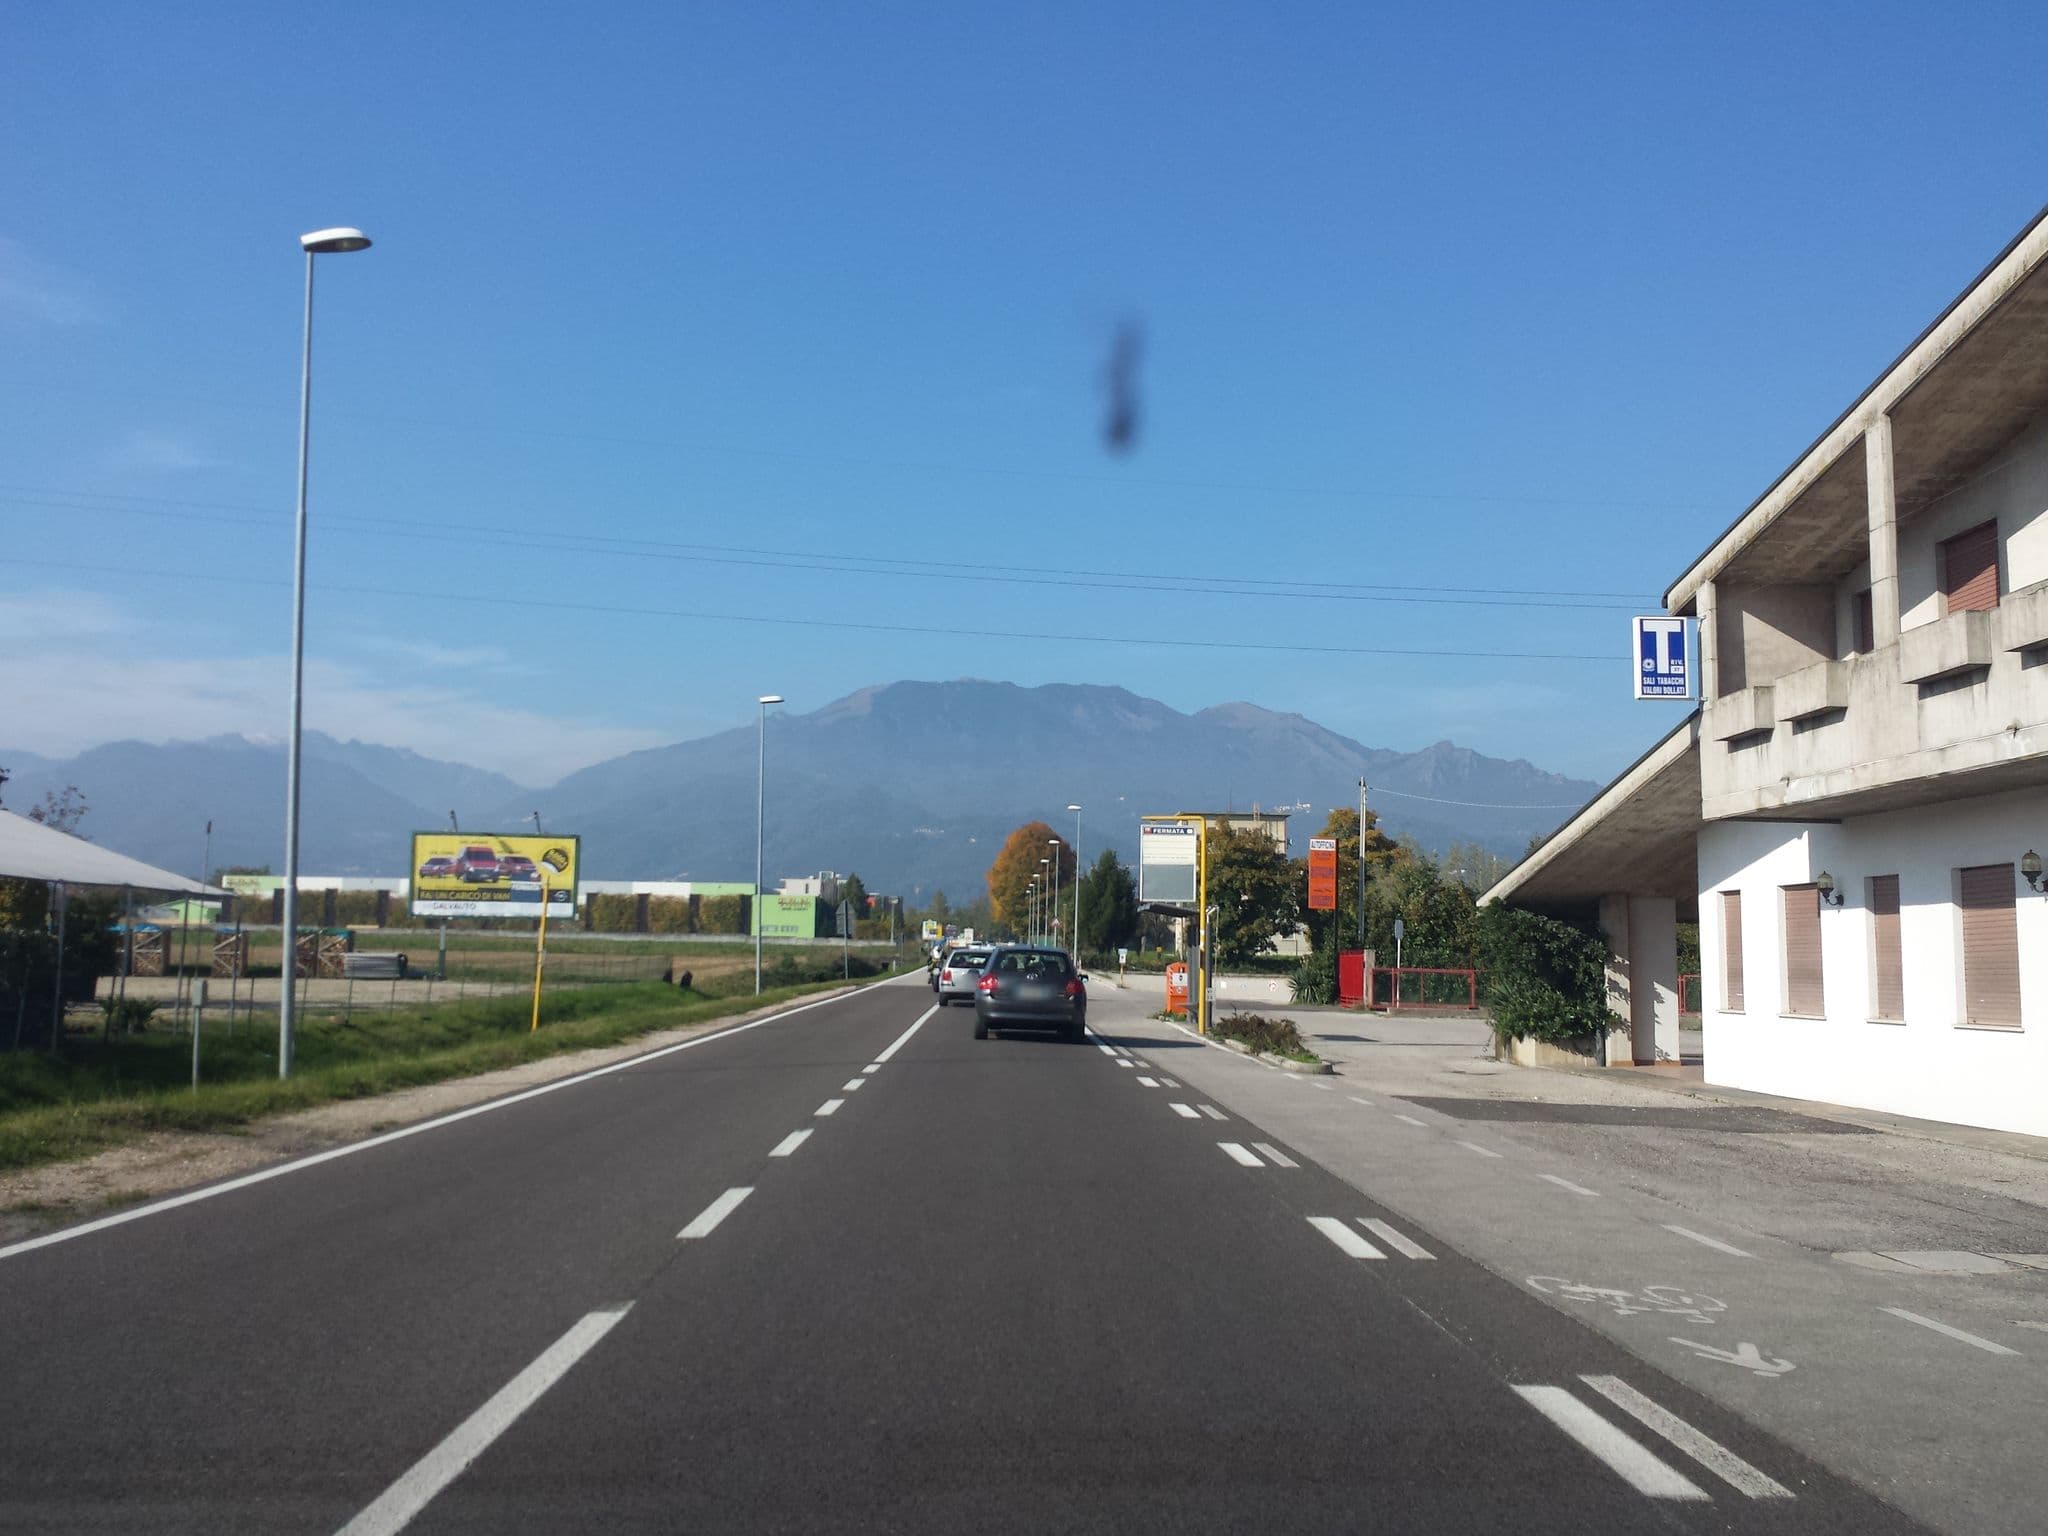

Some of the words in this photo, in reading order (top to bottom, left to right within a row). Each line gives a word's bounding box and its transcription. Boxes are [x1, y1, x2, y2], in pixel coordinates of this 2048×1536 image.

[1643, 620, 1681, 673] T
[1643, 677, 1655, 685] SALI
[1657, 676, 1684, 685] TABACCHI
[1643, 686, 1662, 694] VALORI
[1663, 686, 1685, 694] BOLLATI
